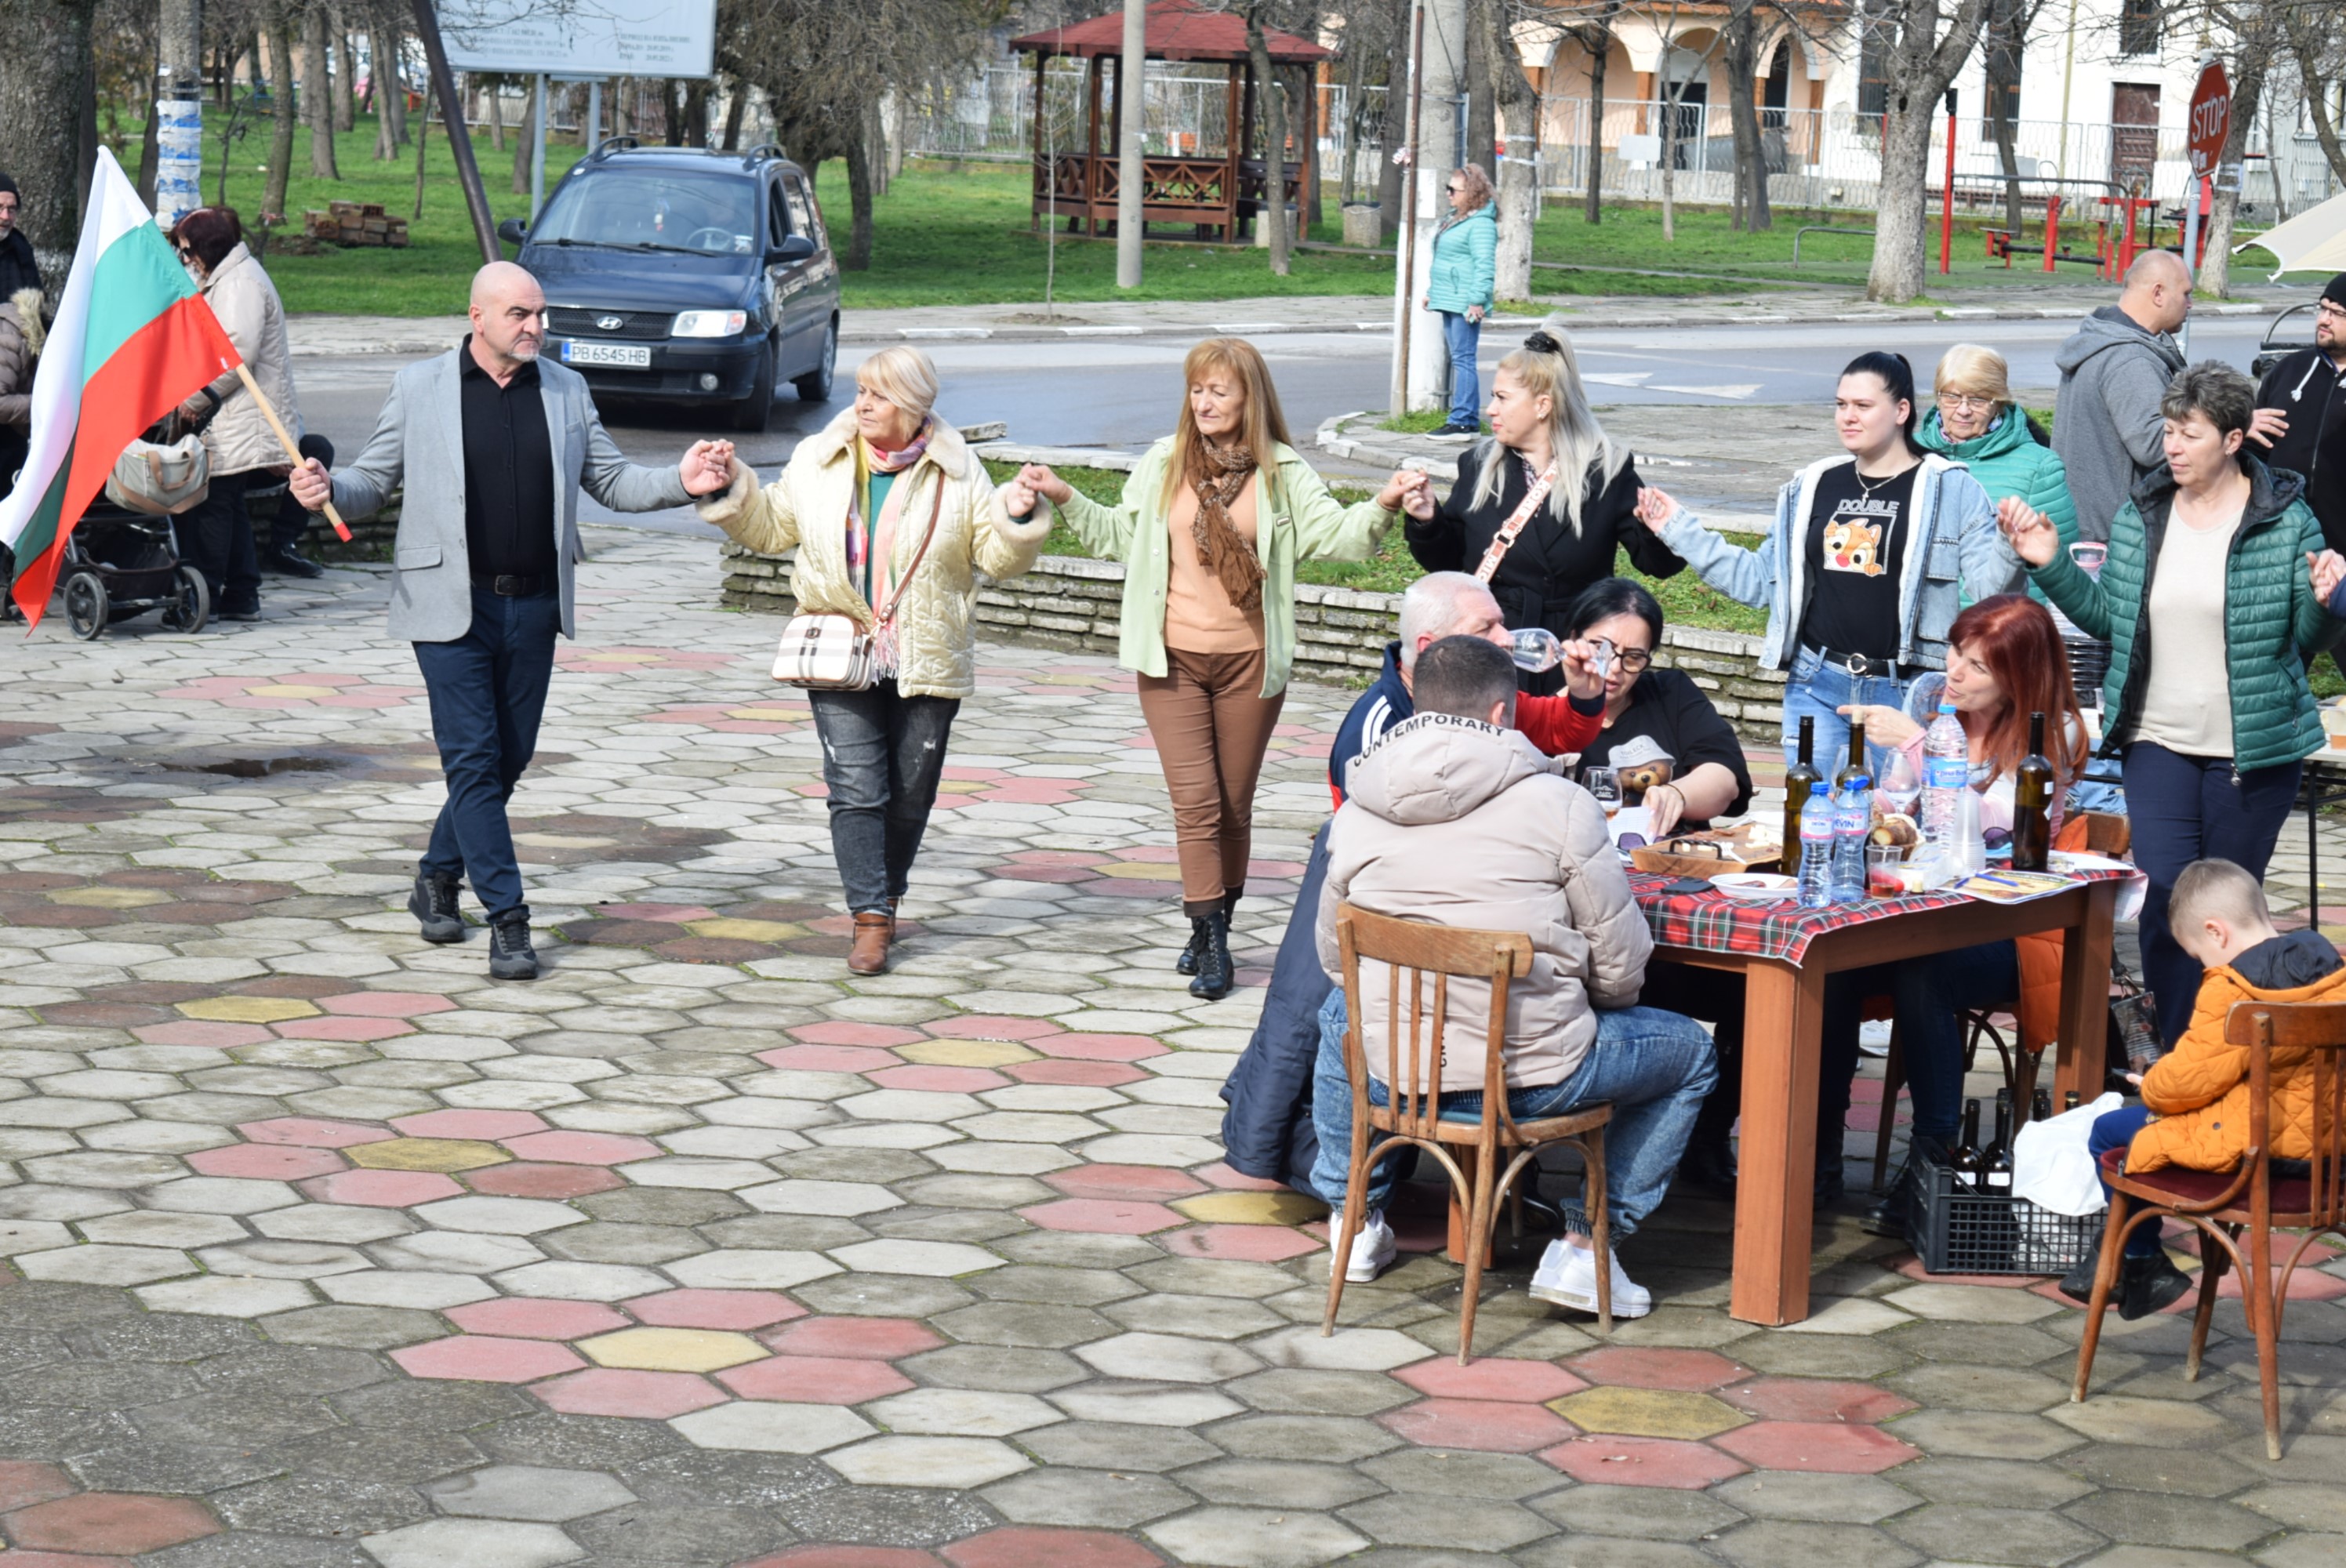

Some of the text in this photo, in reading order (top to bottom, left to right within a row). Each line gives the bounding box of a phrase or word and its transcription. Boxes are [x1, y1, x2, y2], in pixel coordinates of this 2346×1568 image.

[2192, 95, 2227, 143] STOP
[572, 346, 647, 363] PB 6545 HB
[1837, 499, 1900, 514] DOUBLE
[1353, 714, 1505, 768] CONTEMPORARY
[1835, 818, 1854, 828] EVIN
